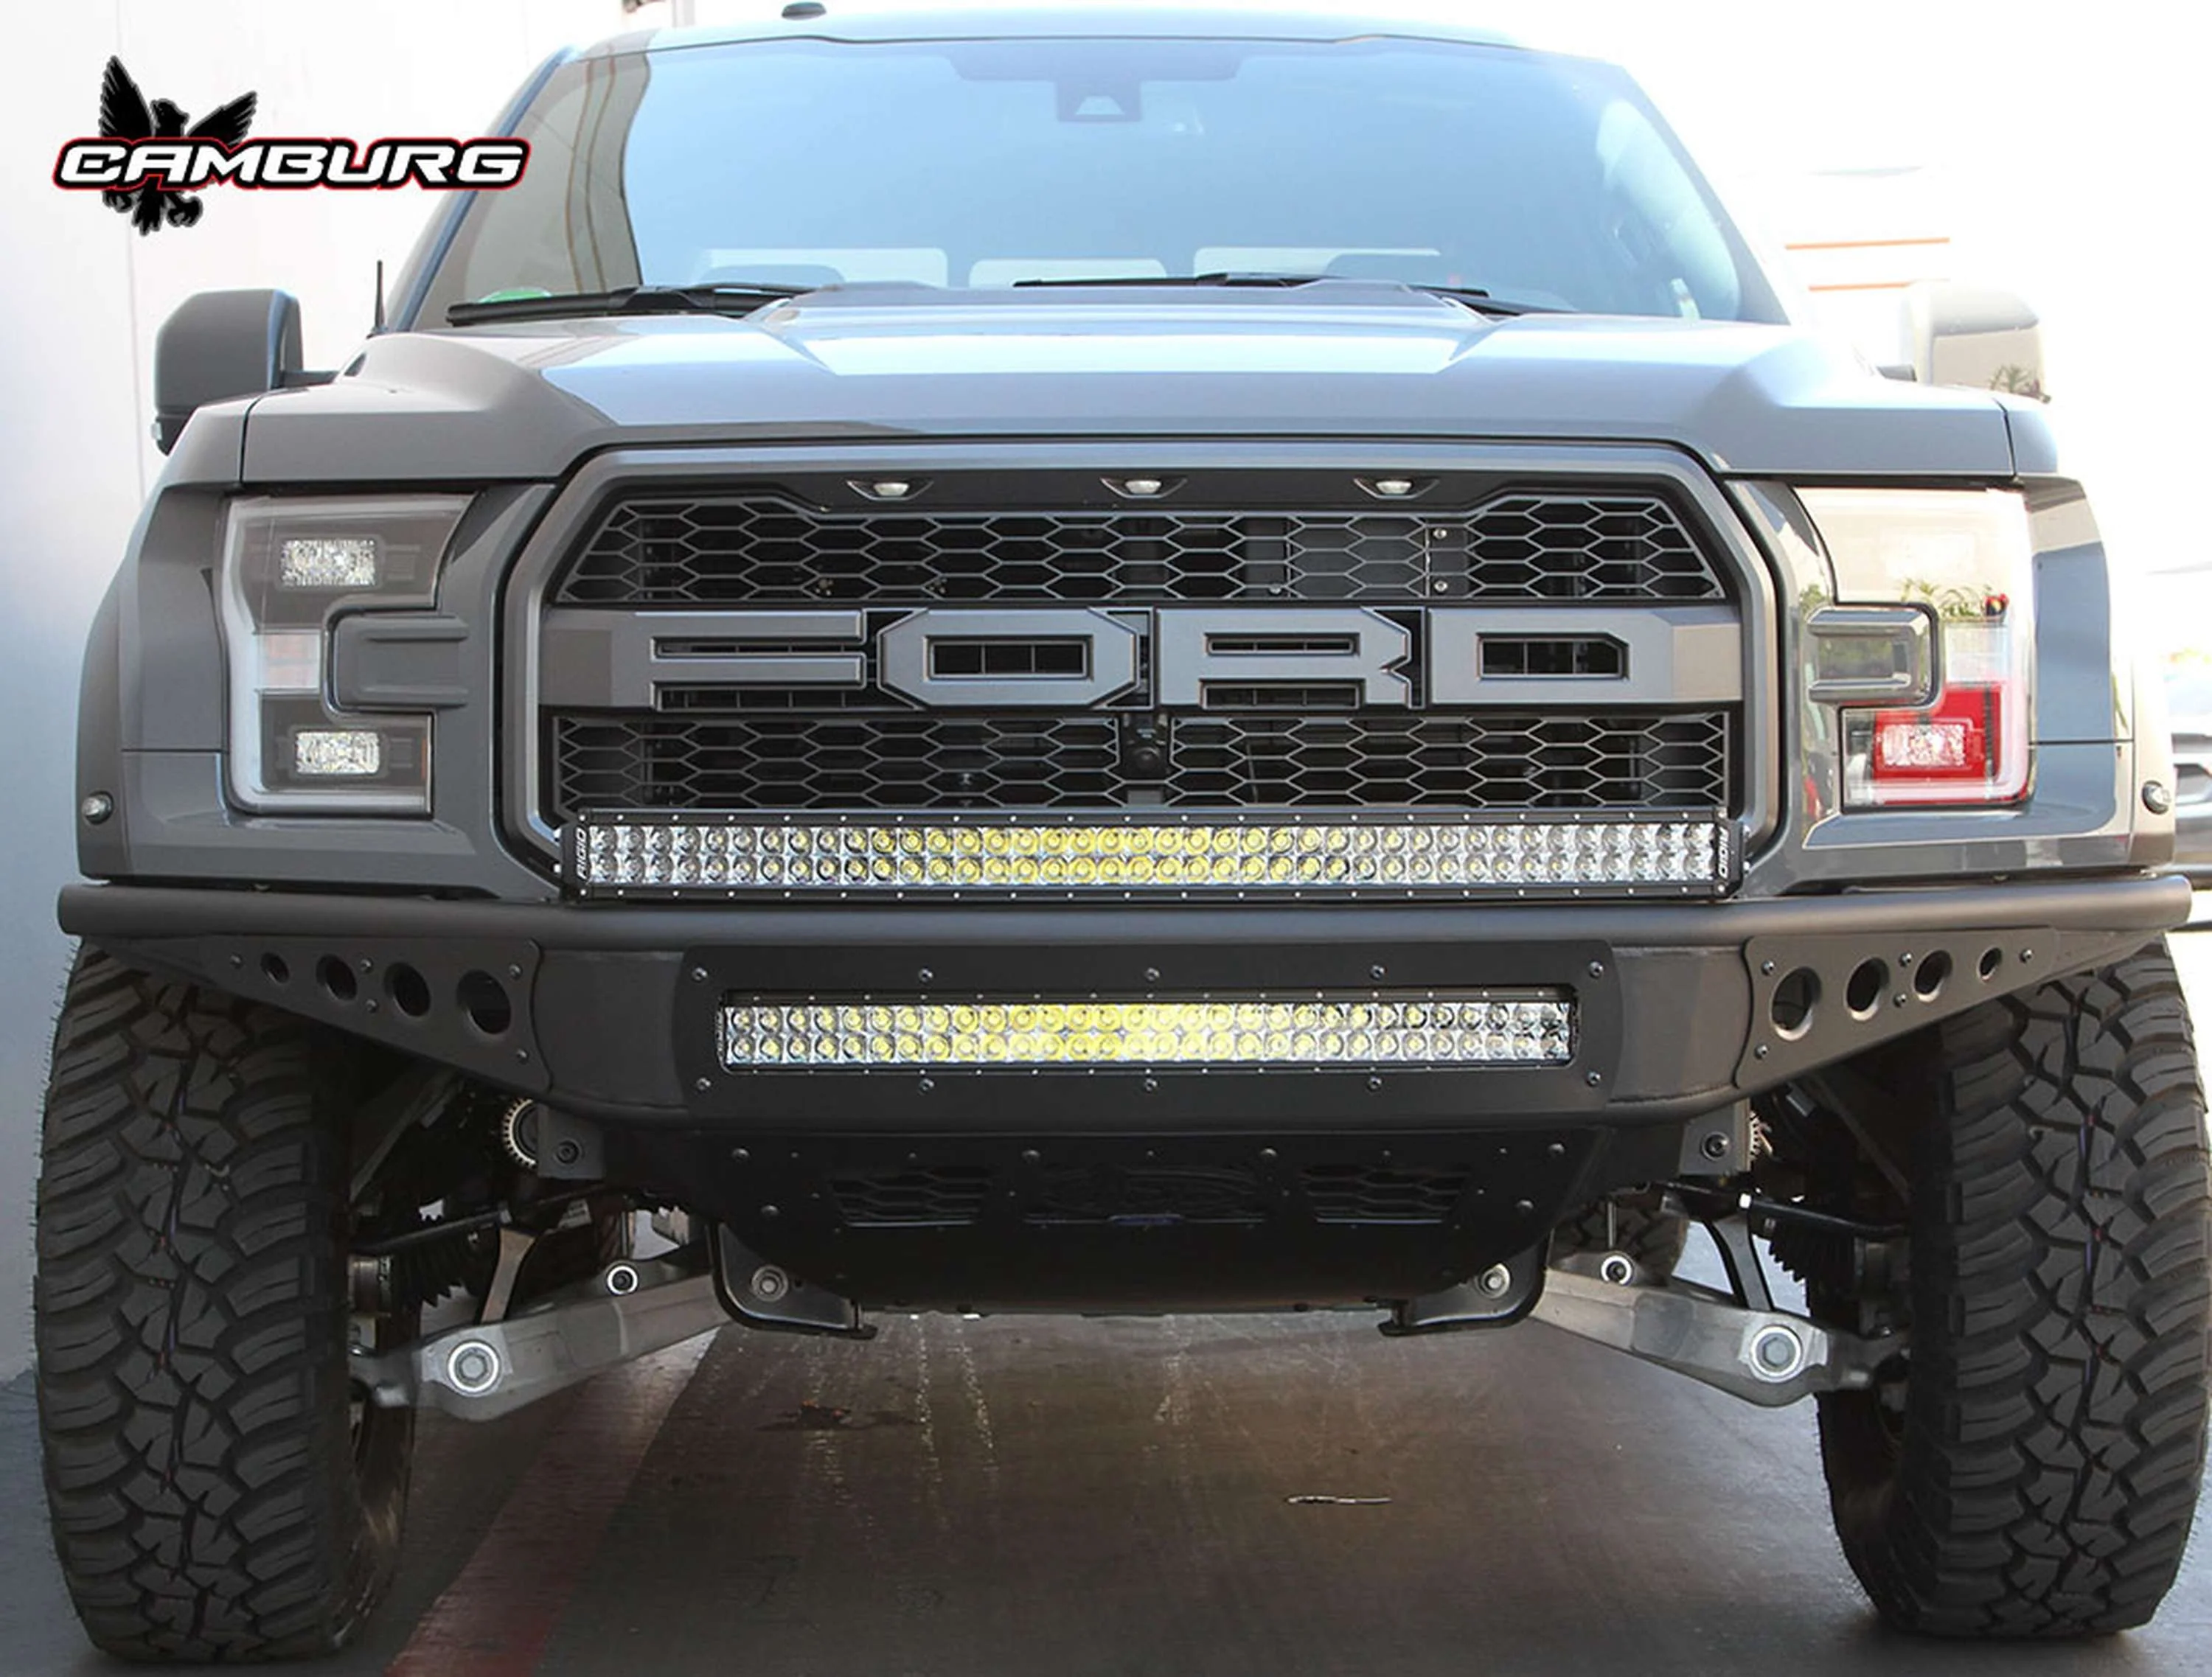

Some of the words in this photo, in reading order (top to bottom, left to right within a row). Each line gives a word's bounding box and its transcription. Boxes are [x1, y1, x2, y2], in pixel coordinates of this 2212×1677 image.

[613, 607, 1675, 711] FORD
[576, 826, 587, 879] RIGID
[1719, 826, 1729, 879] RIGID
